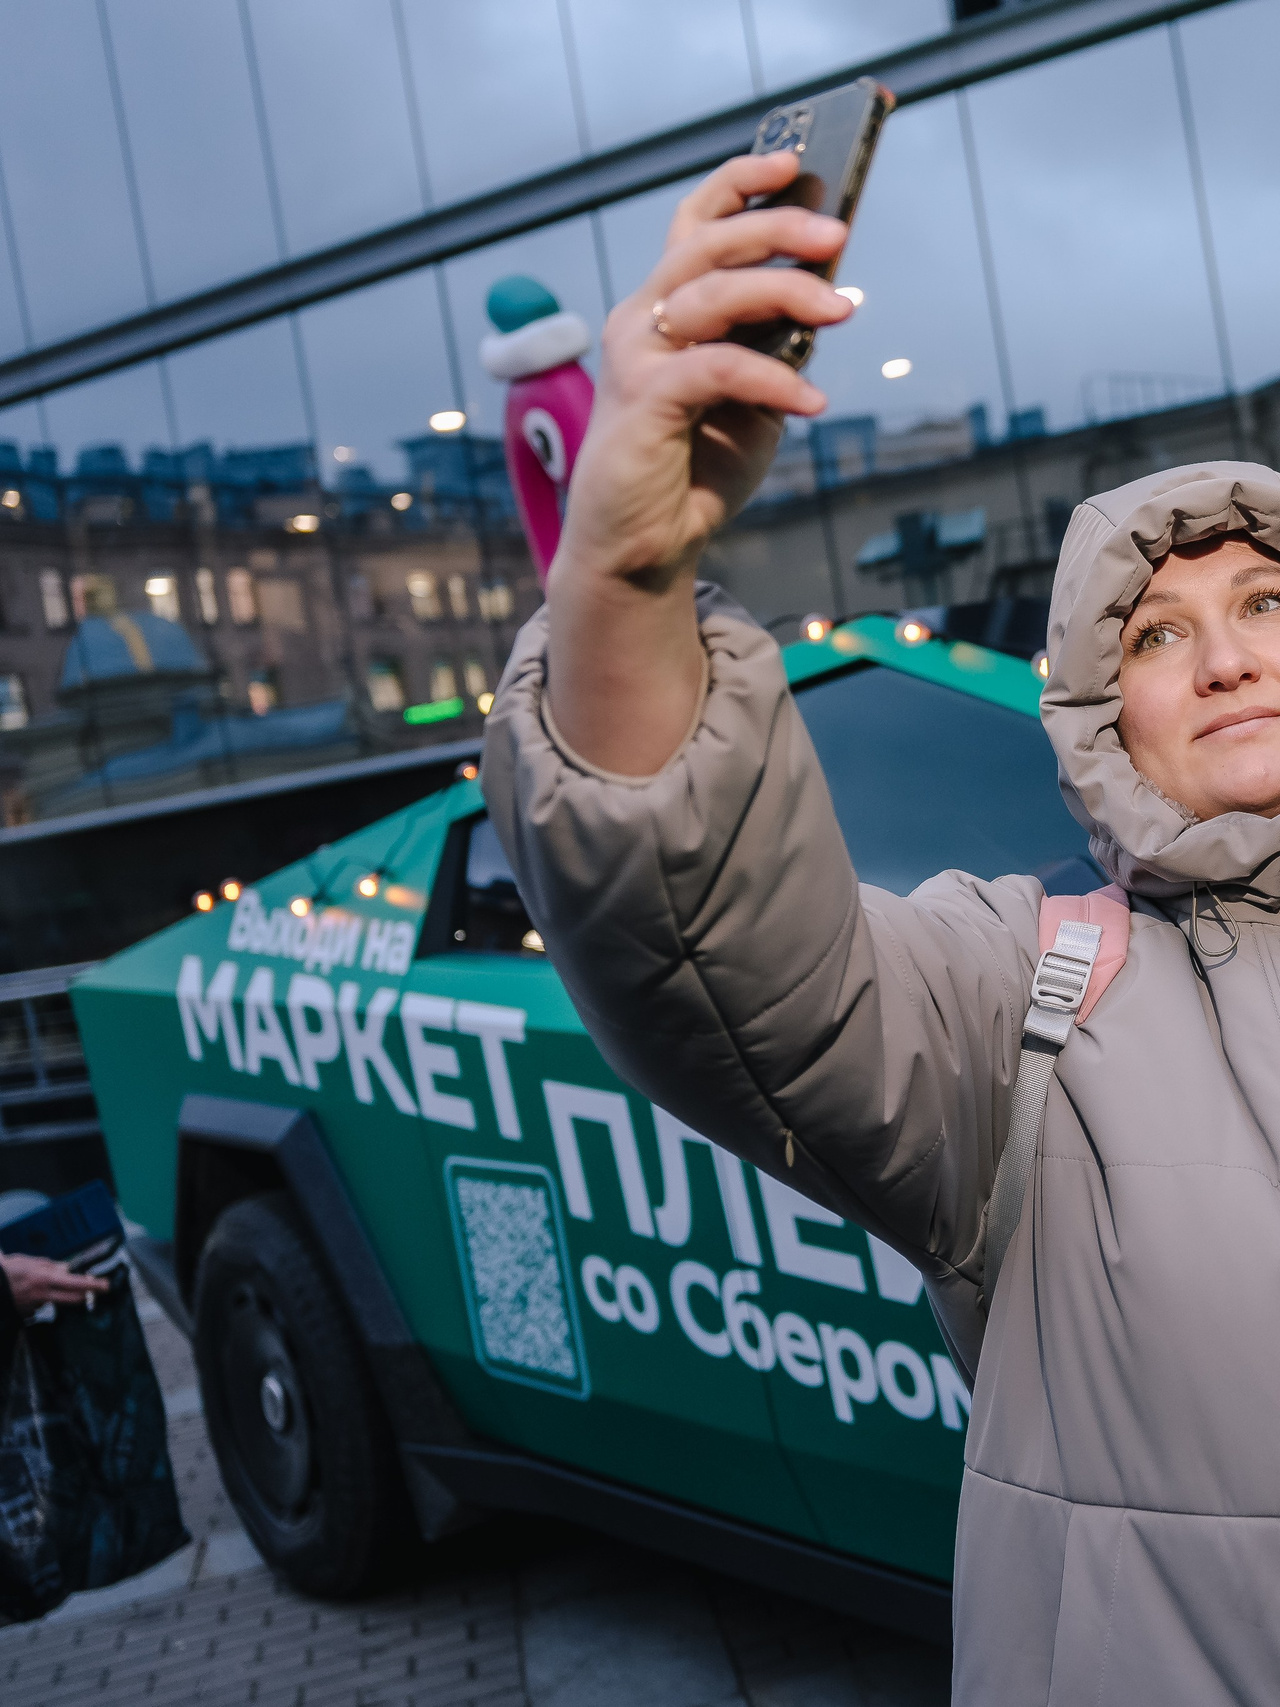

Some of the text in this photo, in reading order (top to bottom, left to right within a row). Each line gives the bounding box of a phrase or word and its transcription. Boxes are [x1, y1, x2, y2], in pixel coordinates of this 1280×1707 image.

[228, 889, 416, 976] Выходи на
[176, 954, 527, 1141] МАРКЕТ
[580, 1255, 660, 1334] со
